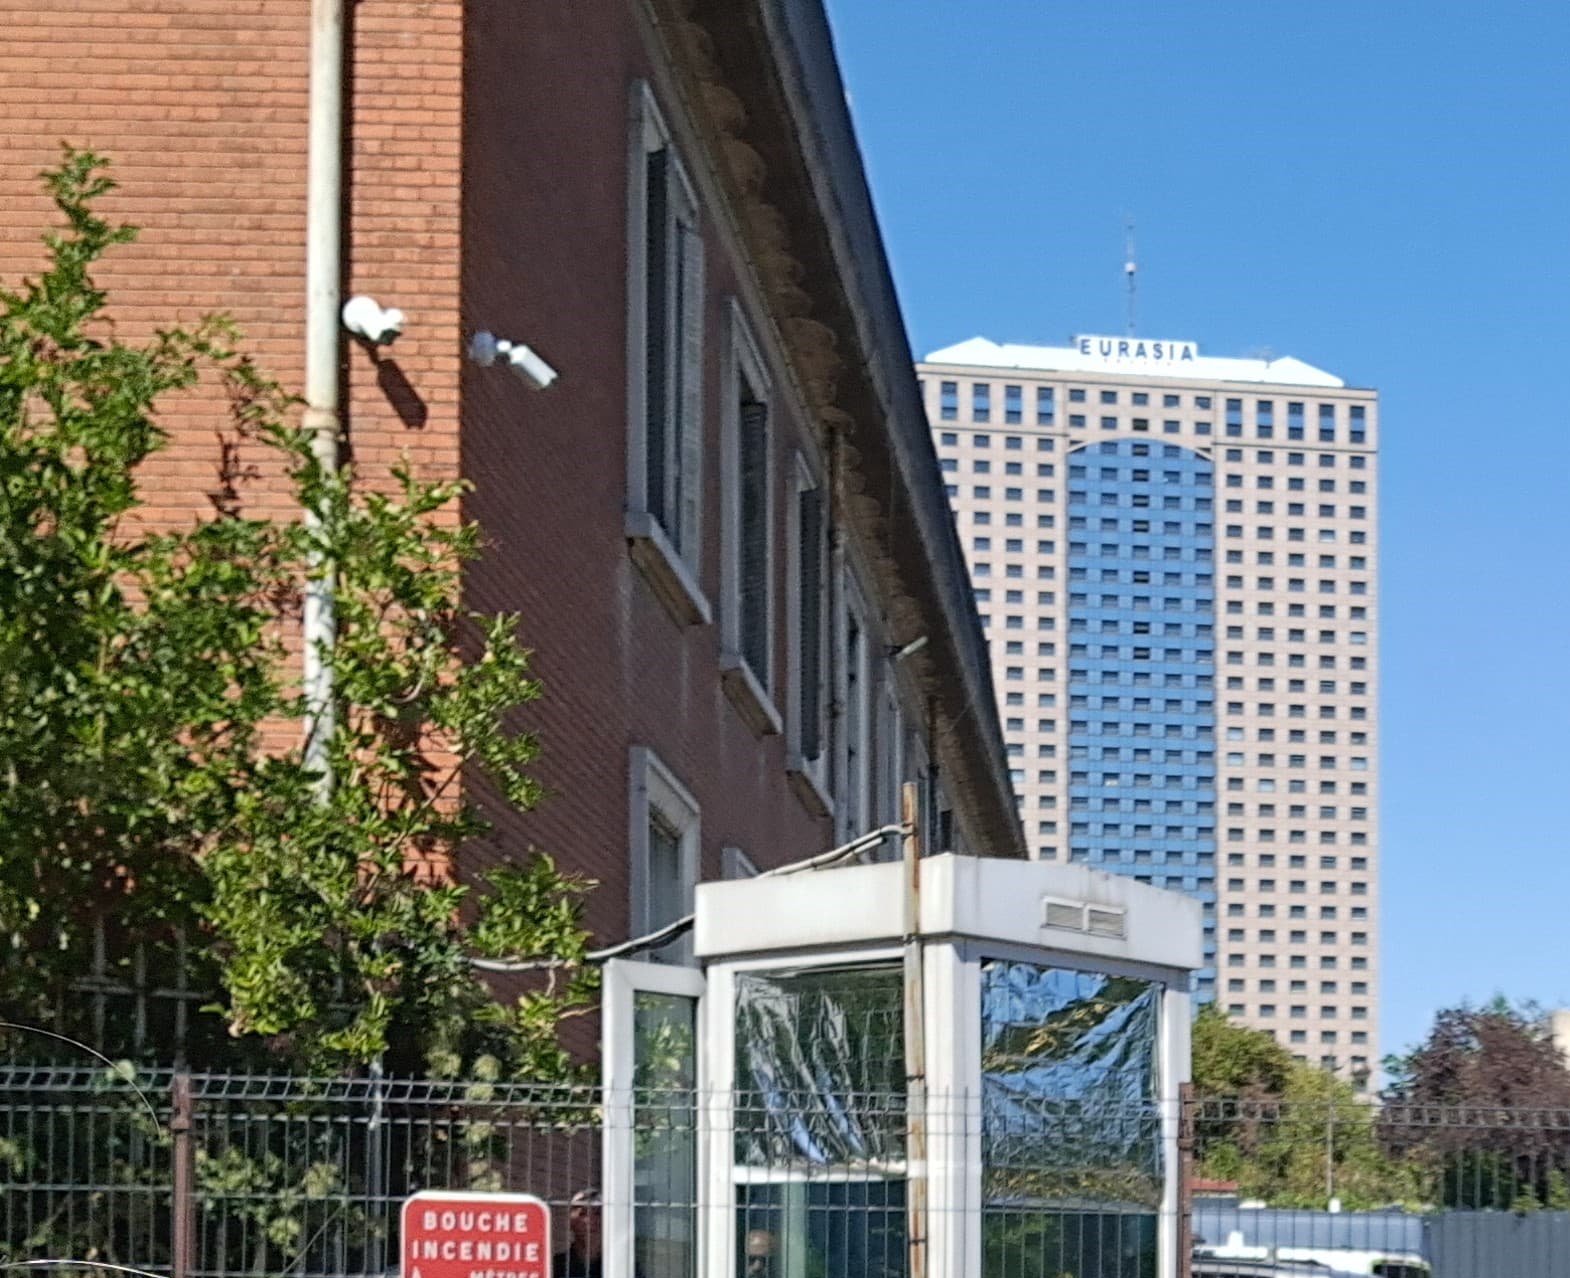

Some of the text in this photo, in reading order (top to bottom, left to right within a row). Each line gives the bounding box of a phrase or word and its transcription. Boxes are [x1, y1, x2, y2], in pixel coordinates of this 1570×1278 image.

[1079, 338, 1193, 361] EURASIA
[423, 1210, 528, 1233] BOUCHE
[412, 1239, 540, 1262] INCENDIE
